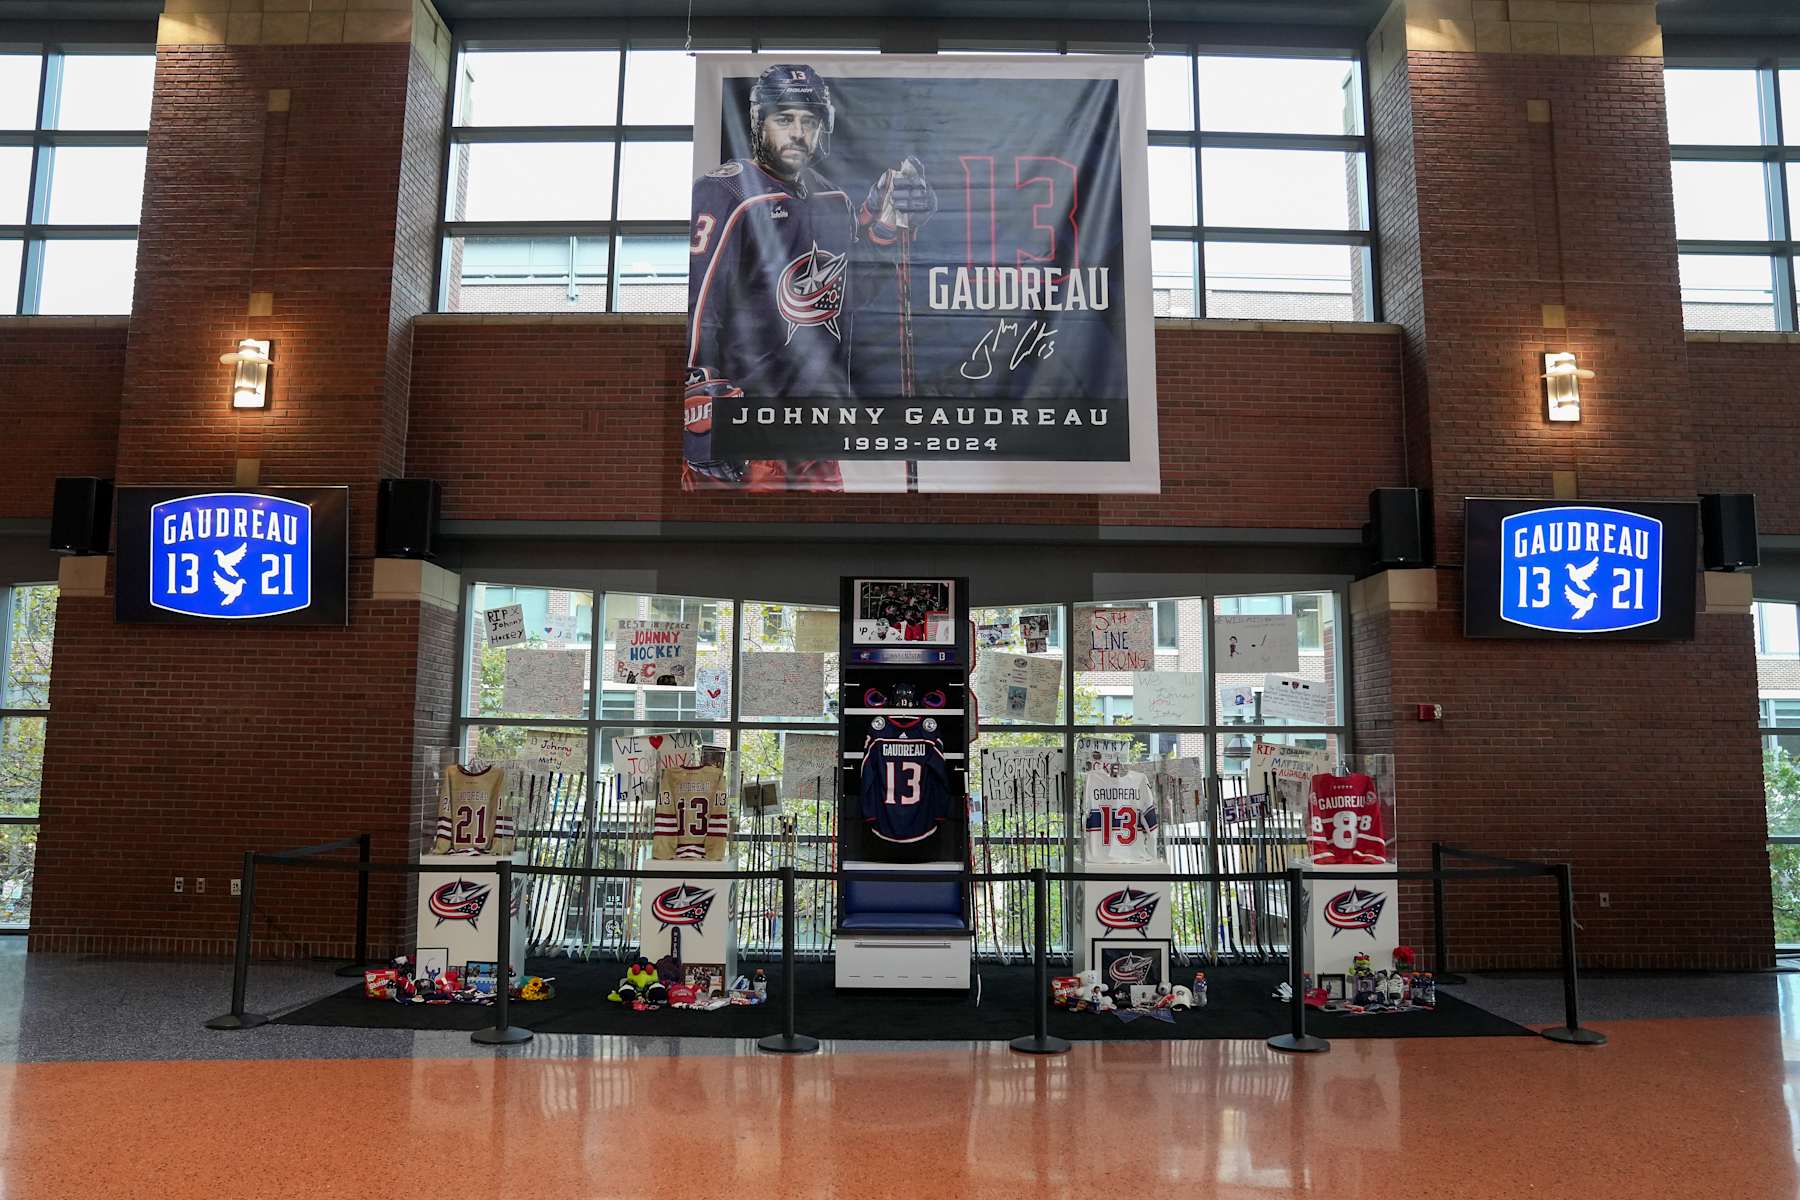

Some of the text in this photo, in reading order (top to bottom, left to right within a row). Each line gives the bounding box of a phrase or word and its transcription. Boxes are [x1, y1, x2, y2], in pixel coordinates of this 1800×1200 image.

[791, 70, 807, 80] 13
[960, 156, 1079, 284] 13
[928, 266, 1109, 311] GAUDREAU
[732, 407, 1108, 426] JOHNNY GAUDREAU
[843, 437, 998, 451] 1993-2024
[163, 507, 298, 545] GAUDREAU
[1514, 521, 1649, 560] GAUDREAU
[167, 552, 293, 595] 13 21
[1517, 566, 1643, 609] 13 21
[487, 609, 508, 623] RIP
[630, 629, 681, 646] JOHNNY
[1091, 631, 1129, 650] LINE
[630, 645, 681, 661] HOCKEY
[1084, 648, 1148, 671] STRONG
[615, 736, 642, 755] WE
[882, 744, 926, 756] GAUDREAU
[1256, 744, 1276, 756] RIP
[884, 761, 922, 805] 13
[714, 792, 727, 806] 13
[1093, 788, 1140, 801] GAUDREAU
[455, 805, 487, 844] 21
[677, 797, 709, 836] 13
[1100, 805, 1137, 846] 13
[1359, 815, 1372, 831] 8
[1332, 811, 1358, 849] 8
